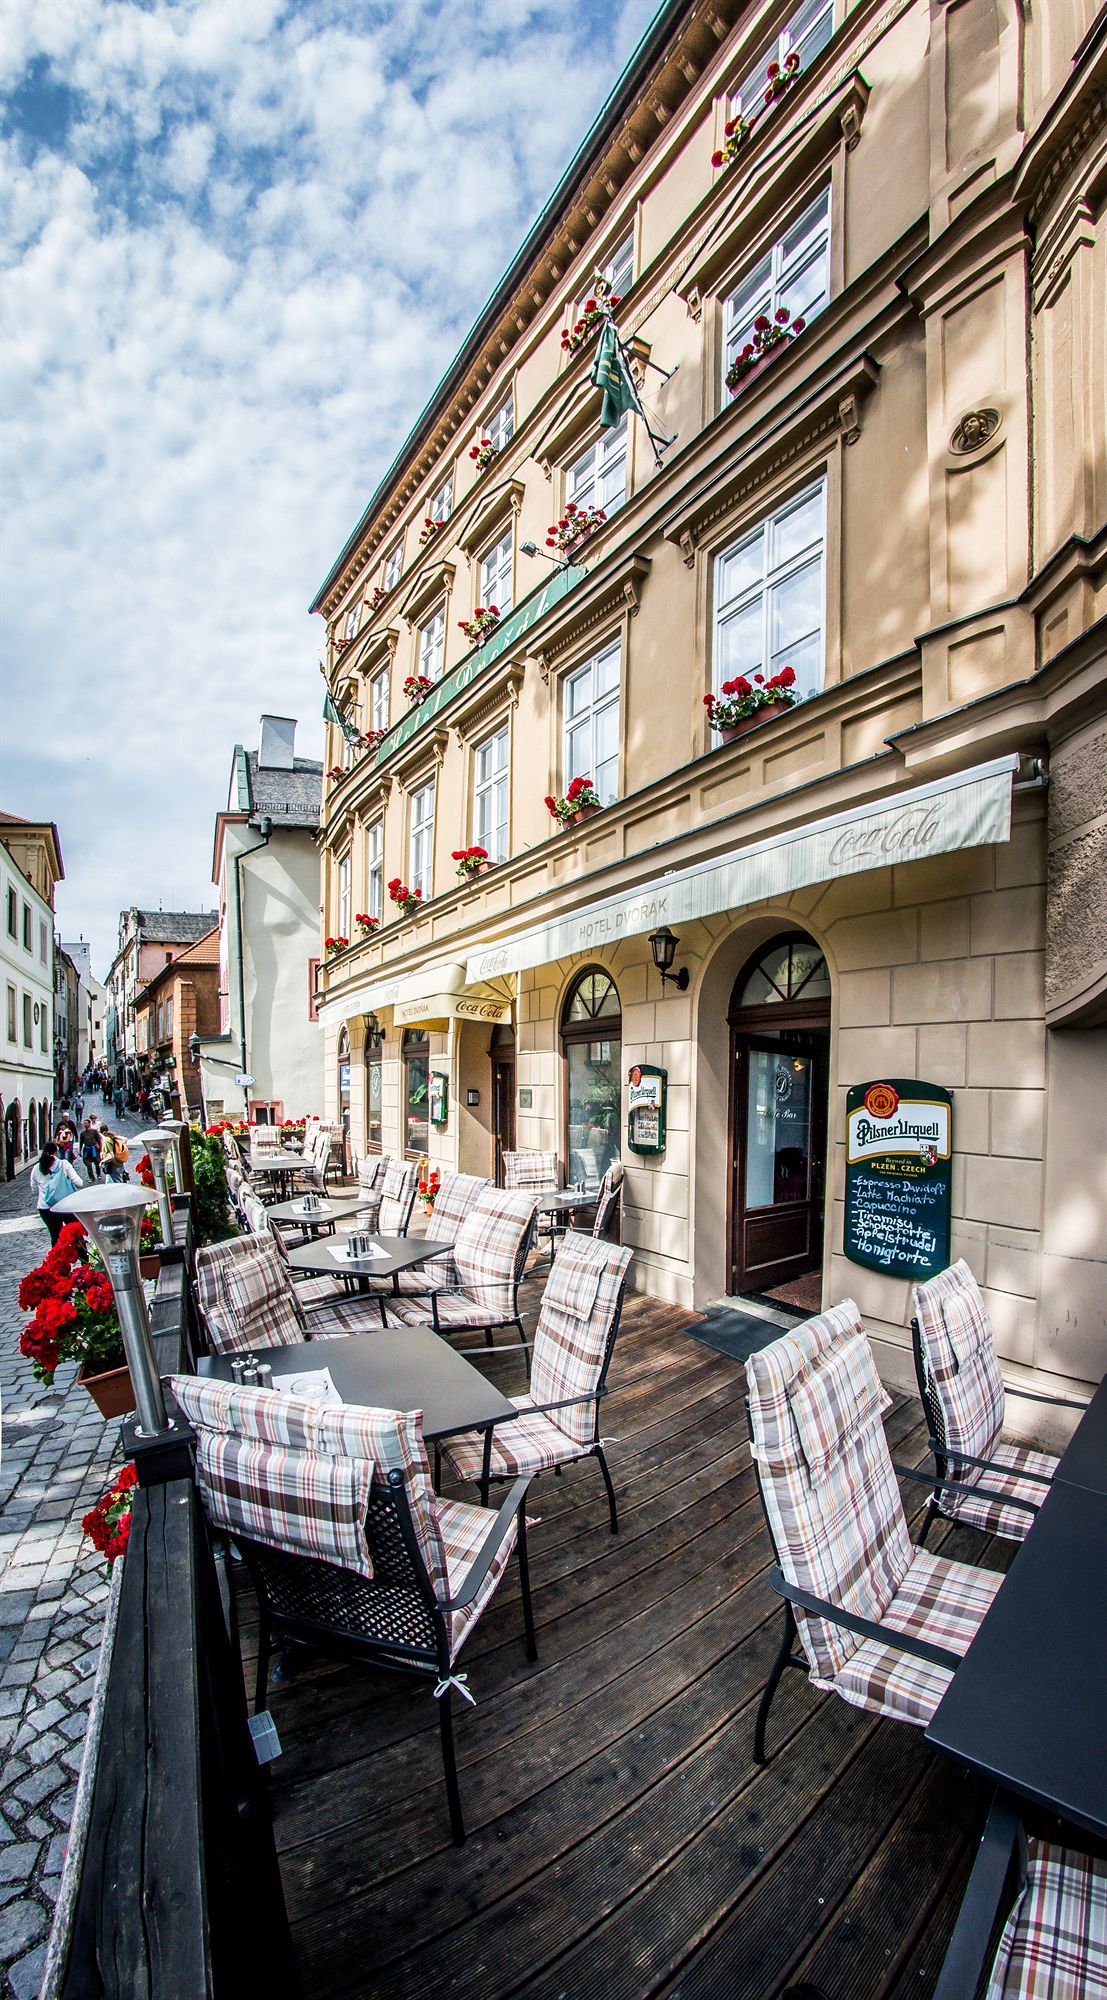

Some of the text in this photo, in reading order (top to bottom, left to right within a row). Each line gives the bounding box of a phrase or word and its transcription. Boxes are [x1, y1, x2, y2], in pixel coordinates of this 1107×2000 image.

[580, 897, 668, 939] HOTEL DVOŘÁK
[856, 1118, 939, 1147] Pilsner Urquell
[885, 1157, 905, 1165] Brewed
[901, 1165, 926, 1173] CZECH
[902, 1180, 946, 1195] Davidoff
